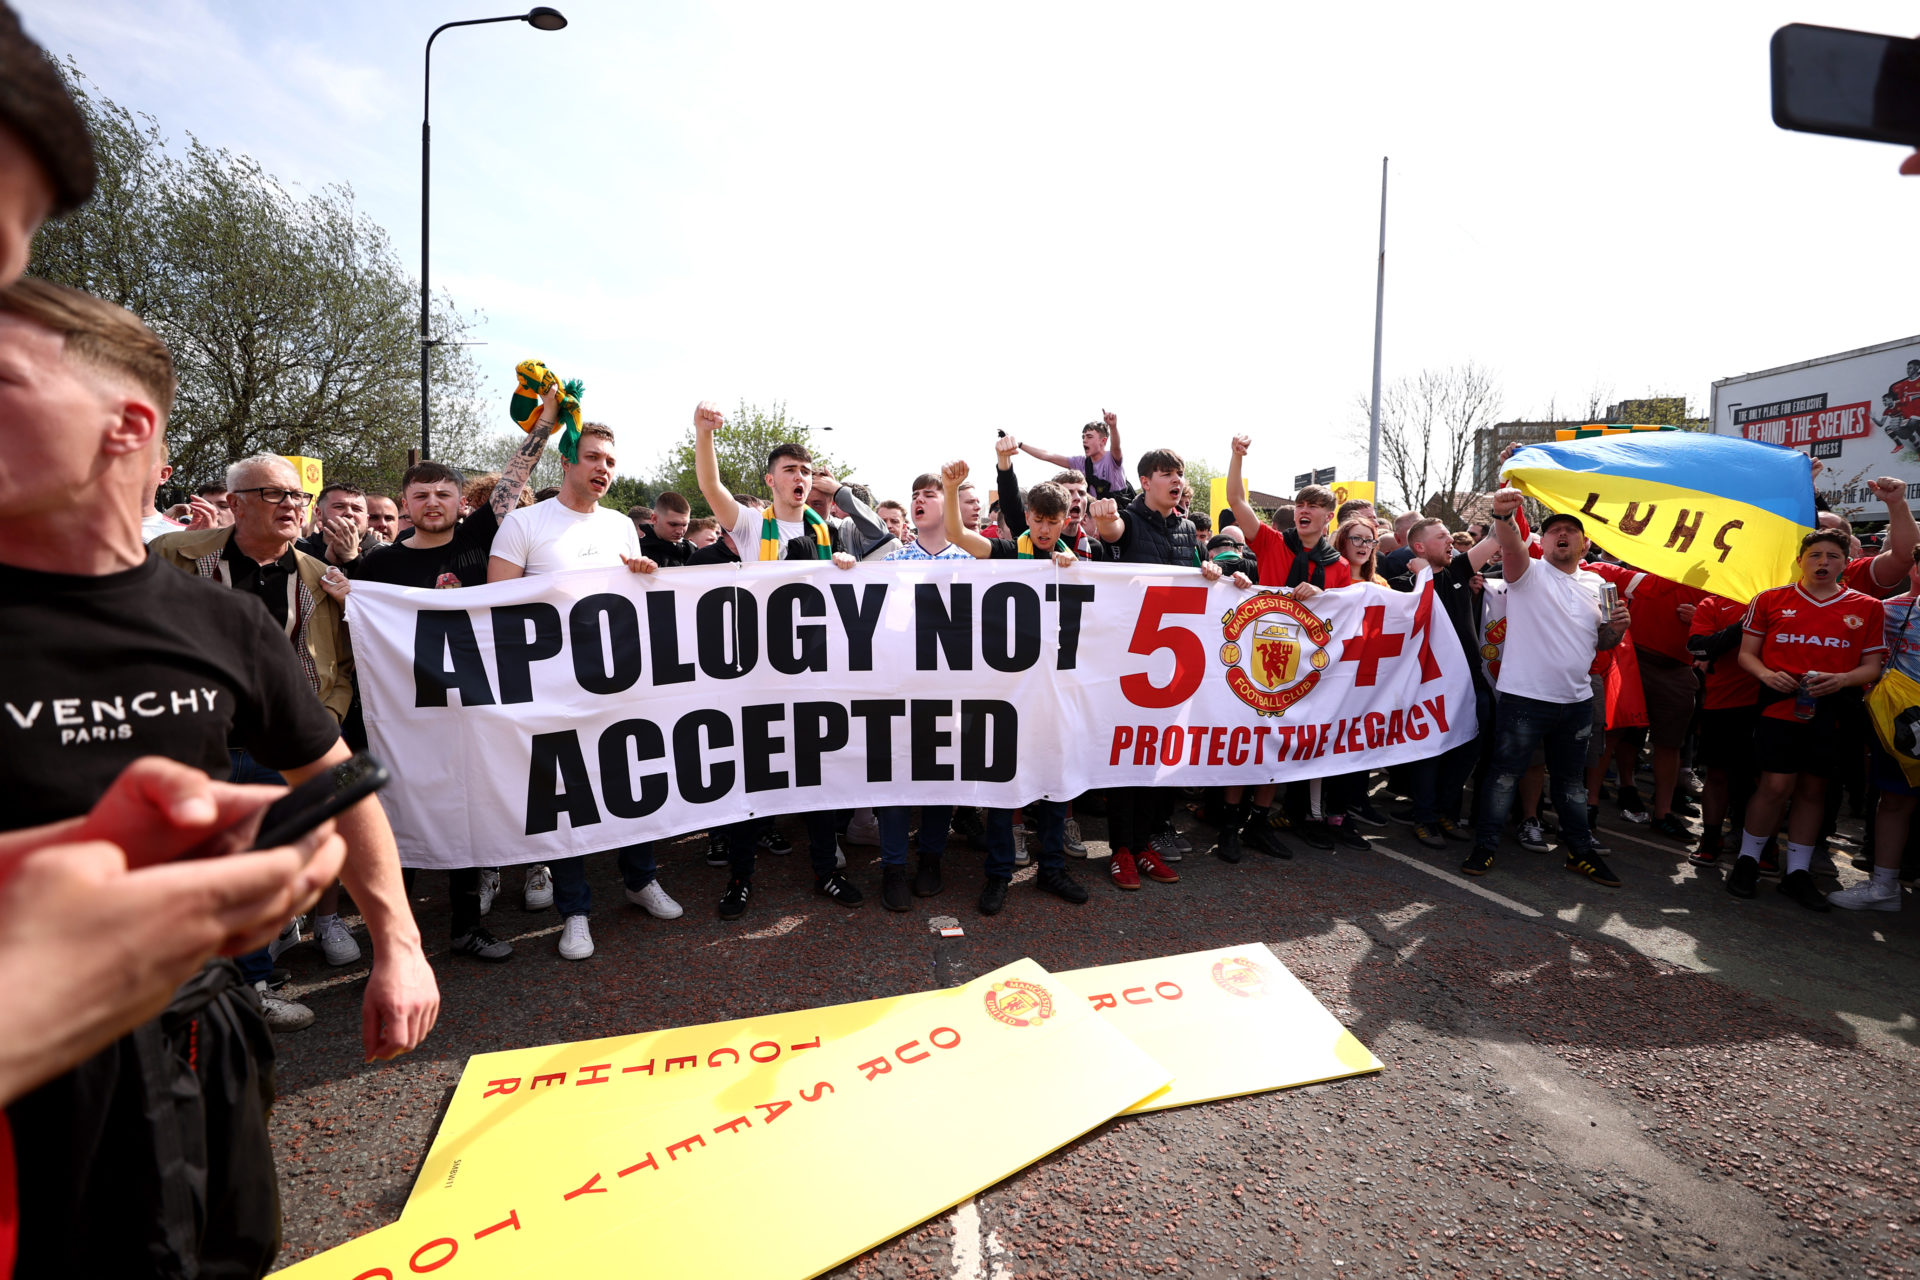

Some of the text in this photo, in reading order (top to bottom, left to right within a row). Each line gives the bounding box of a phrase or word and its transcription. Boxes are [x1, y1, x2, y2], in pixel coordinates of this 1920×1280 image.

[1792, 396, 1824, 413] EXCLUSIVE
[1814, 442, 1839, 457] ACCESS
[1228, 598, 1324, 642] MANCHESTER UNITED
[413, 581, 1096, 708] APOLOGY NOT
[1119, 586, 1209, 709] 5
[1775, 633, 1851, 648] SHARP
[1234, 677, 1312, 708] FOOTBALL CLUB
[61, 723, 133, 746] PARIS
[1109, 694, 1450, 766] PROTECT THE LEGACY
[525, 699, 1018, 836] ACCEPTED
[986, 1000, 1017, 1025] UNITED
[1009, 981, 1050, 1016] MANCHESTER
[1088, 981, 1183, 1012] OUR
[483, 1036, 821, 1099] TOGETHER
[857, 1026, 962, 1081] OUR
[563, 1081, 835, 1202] SAFETY
